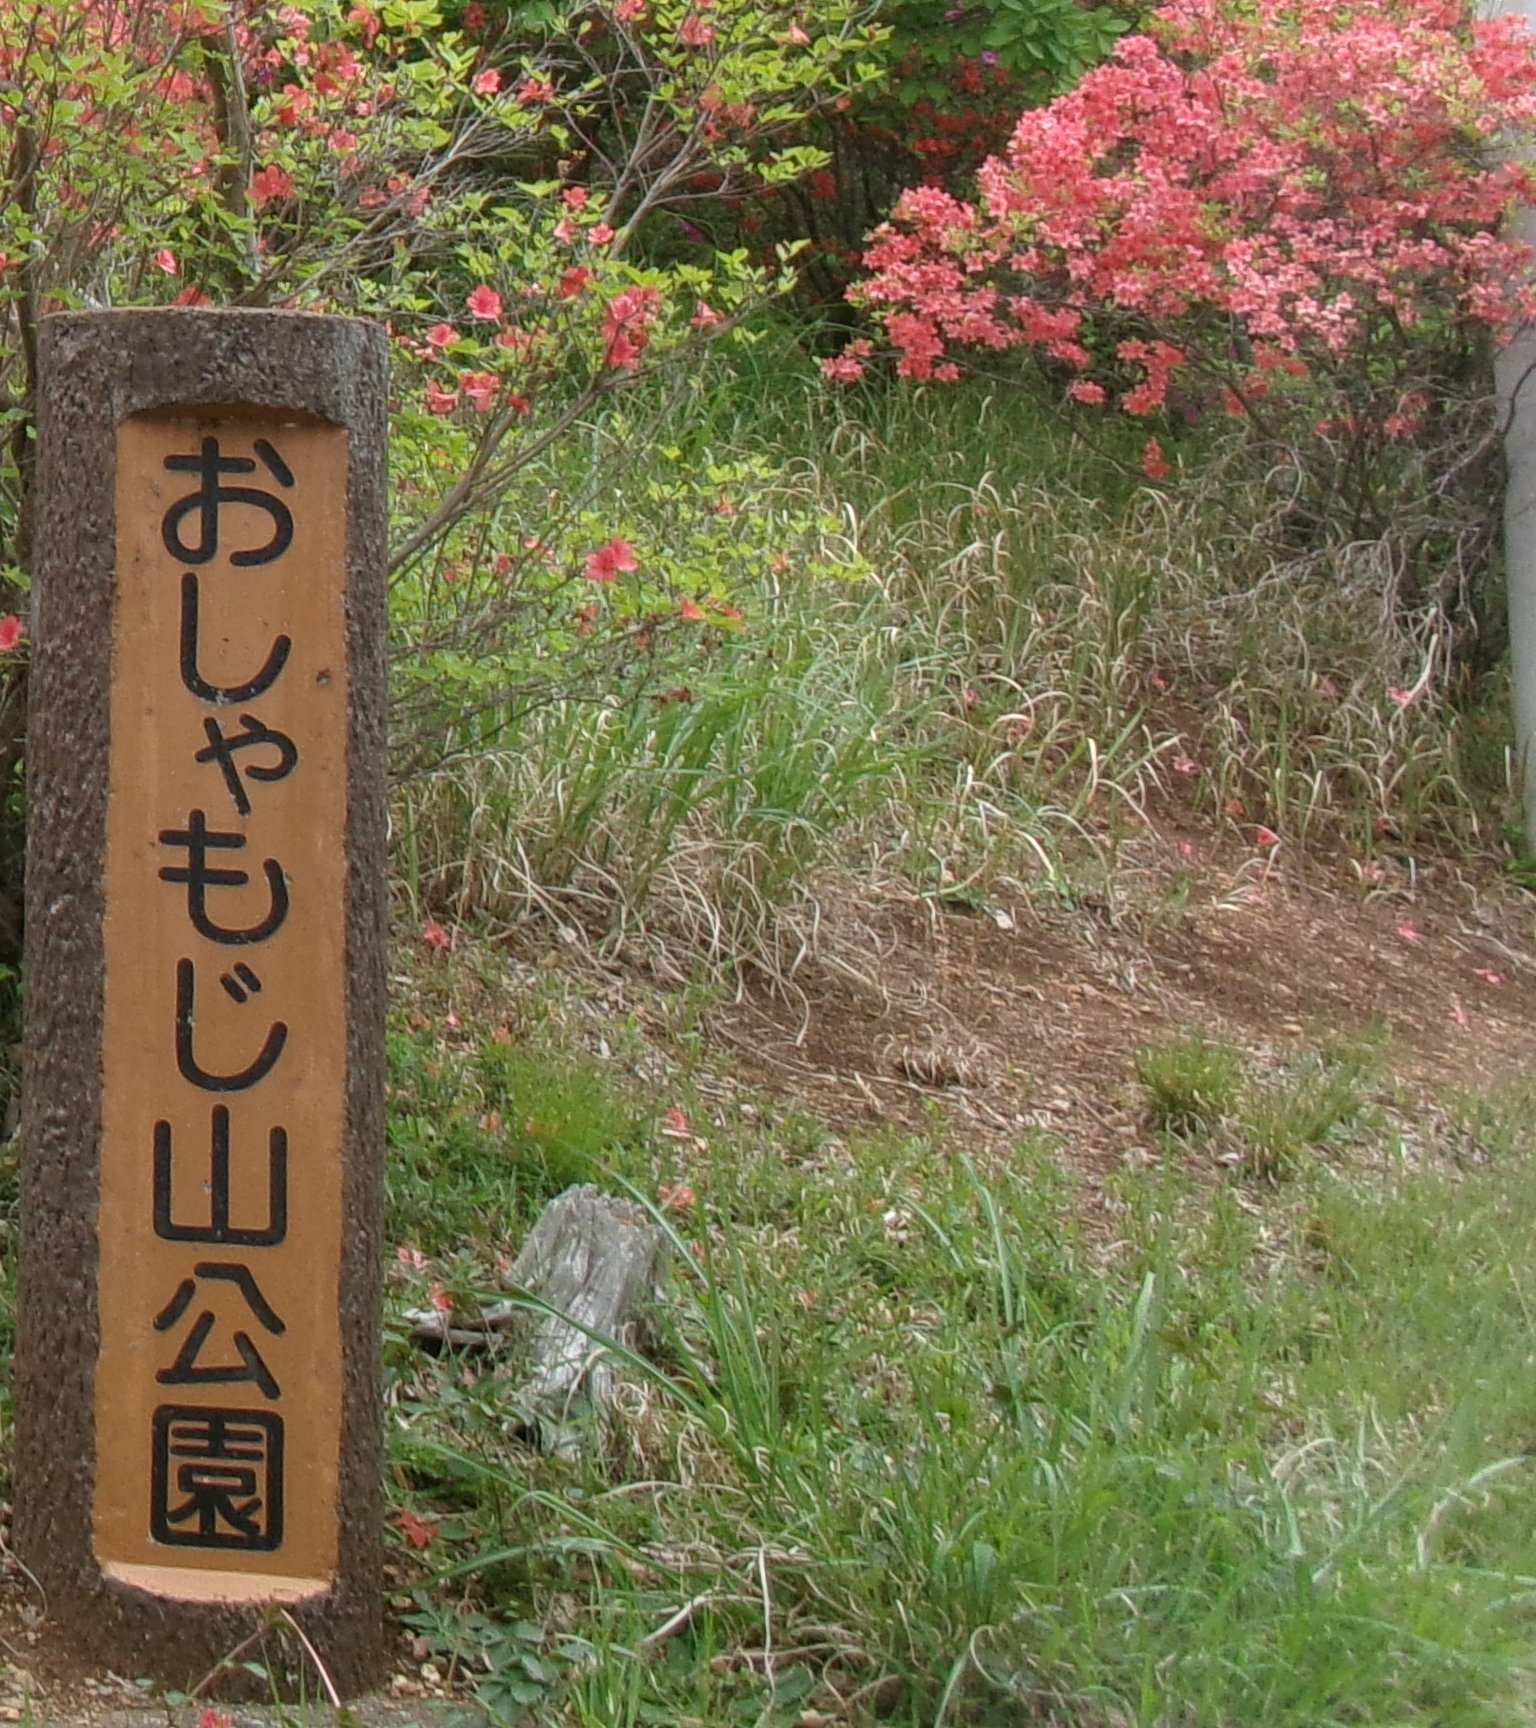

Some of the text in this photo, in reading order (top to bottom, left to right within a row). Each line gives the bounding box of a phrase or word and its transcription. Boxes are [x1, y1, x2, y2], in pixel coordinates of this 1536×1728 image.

[150, 435, 299, 1553] おしゃもじ山公園
